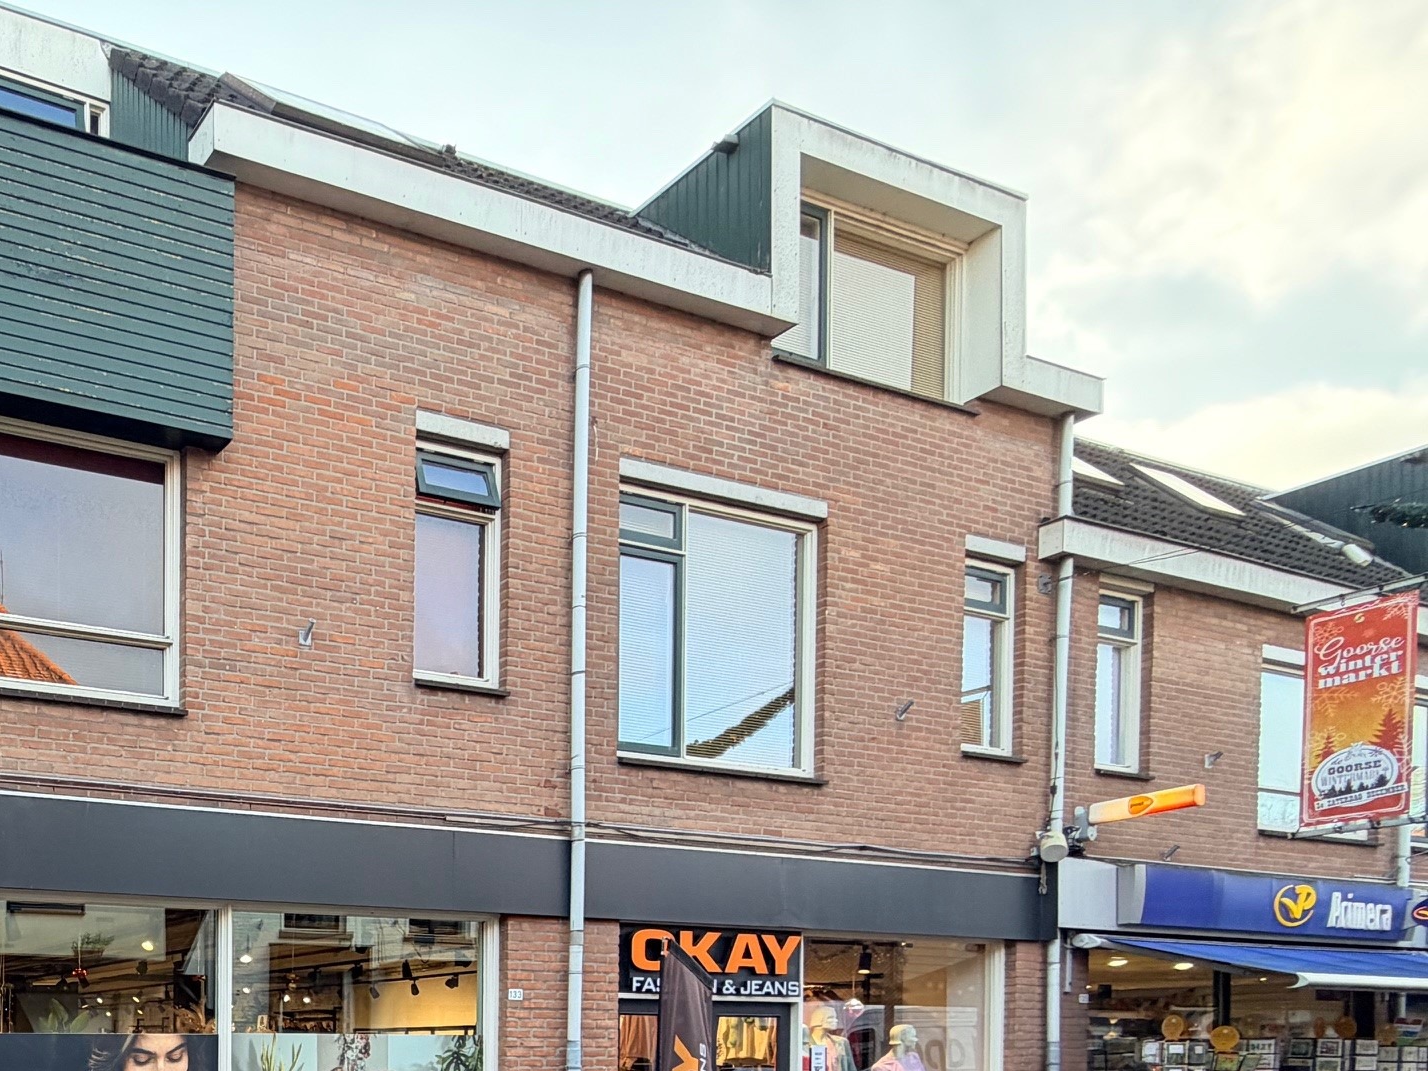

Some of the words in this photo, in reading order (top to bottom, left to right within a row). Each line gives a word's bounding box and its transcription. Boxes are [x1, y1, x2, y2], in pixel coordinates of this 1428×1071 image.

[1314, 636, 1405, 667] Goorse
[1317, 650, 1403, 676] winter
[1317, 660, 1403, 689] markt
[1328, 760, 1382, 775] GOORSE
[1326, 891, 1393, 931] Primera
[631, 928, 801, 975] OKAY
[509, 990, 522, 999] 133
[722, 979, 737, 994] &
[740, 980, 800, 996] JEANS
